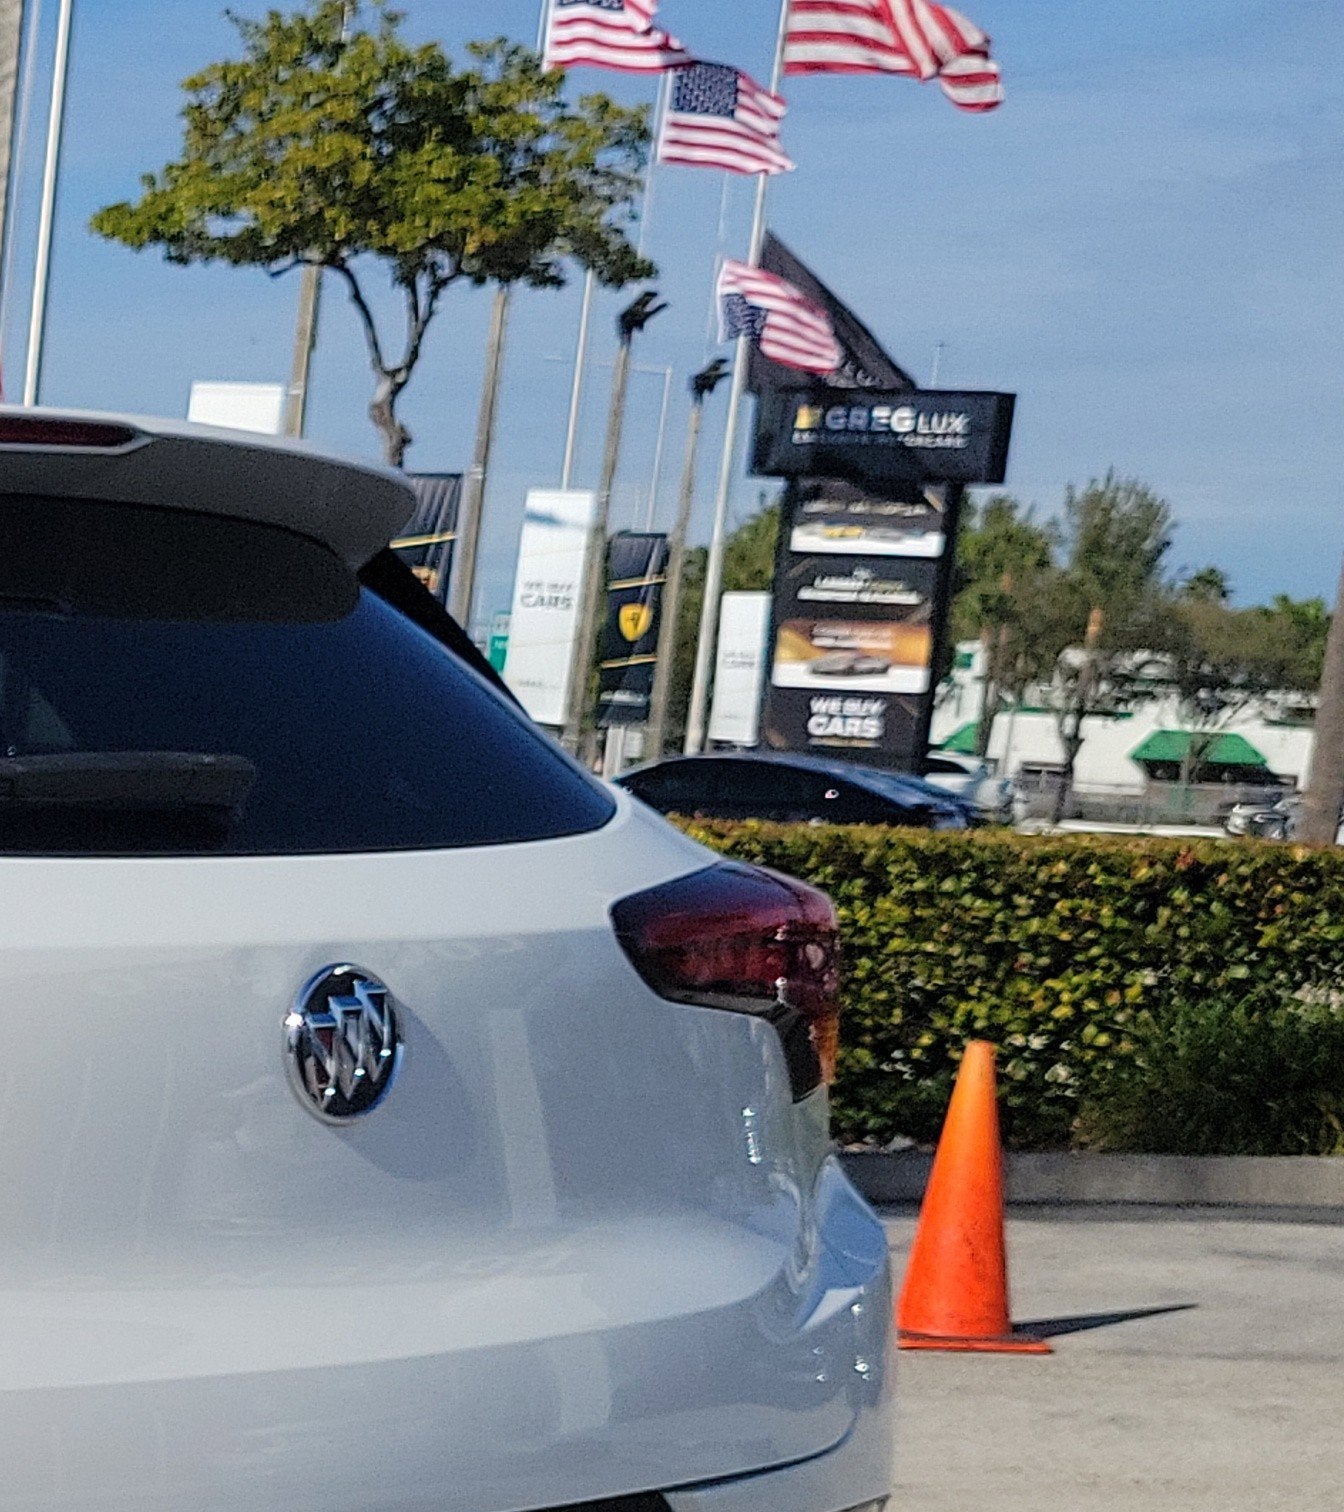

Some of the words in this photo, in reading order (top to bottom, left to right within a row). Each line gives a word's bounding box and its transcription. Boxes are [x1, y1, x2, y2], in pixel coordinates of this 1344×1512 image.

[520, 594, 573, 610] CARS
[810, 697, 842, 715] WE
[843, 699, 887, 717] BUY
[807, 714, 885, 738] CARS
